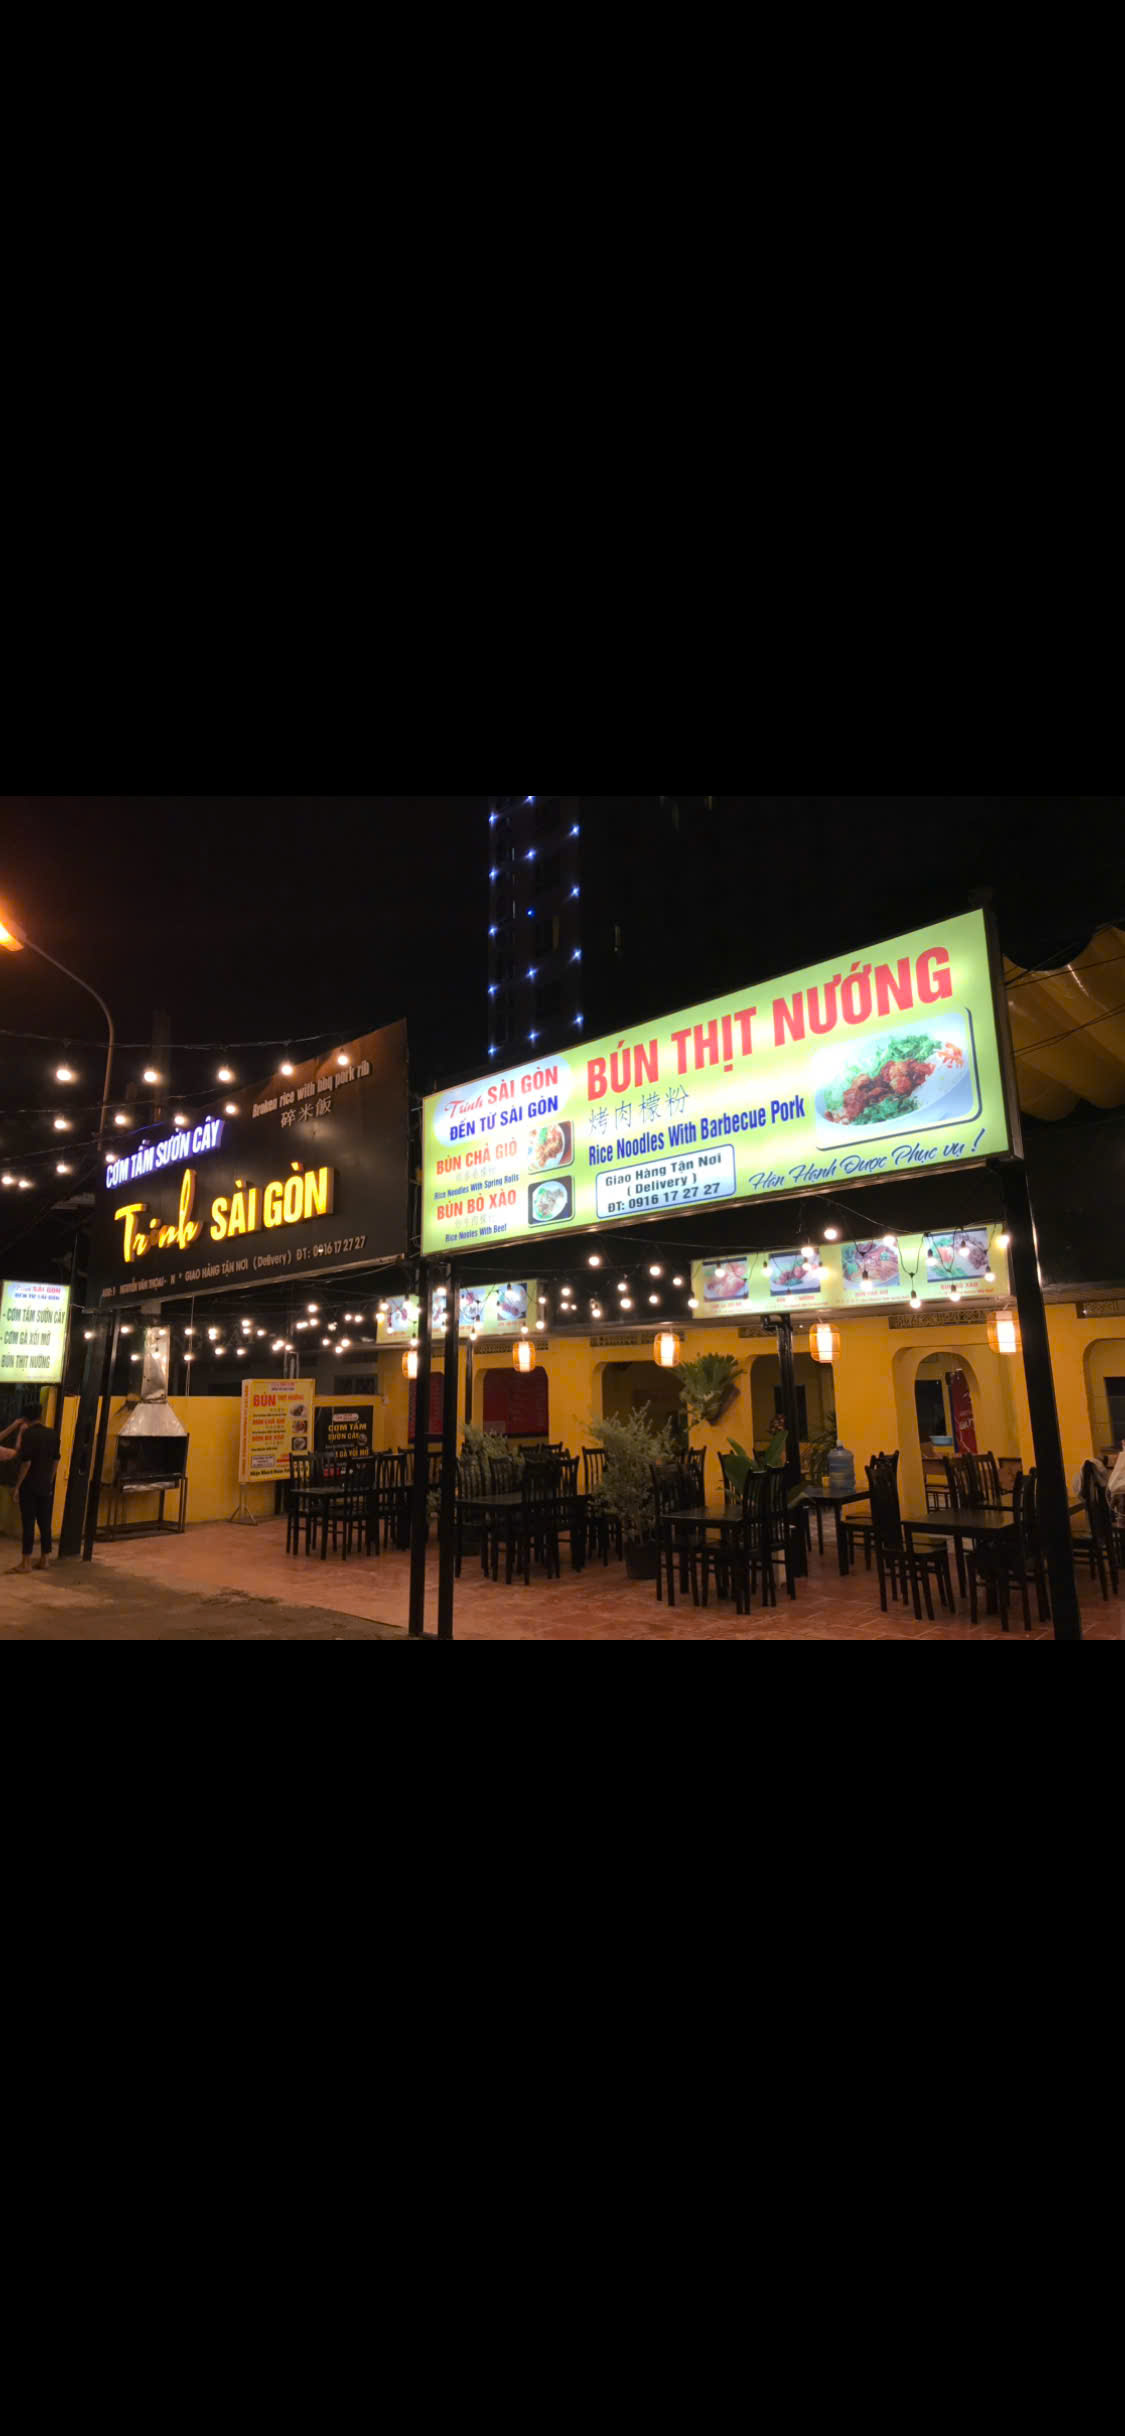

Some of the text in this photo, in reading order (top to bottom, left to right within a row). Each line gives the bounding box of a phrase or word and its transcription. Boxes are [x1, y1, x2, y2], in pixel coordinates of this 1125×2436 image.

[587, 946, 952, 1101] BÚN THỊT NƯỚNG
[279, 1091, 295, 1108] rice
[297, 1081, 315, 1101] with
[335, 1066, 355, 1088] pork
[357, 1060, 370, 1078] rib
[488, 1079, 515, 1104] SÀI
[521, 1066, 558, 1094] GÒN
[192, 1115, 221, 1153] CÂY
[450, 1095, 558, 1141] ĐẾN TỪ SÀI GÒN
[589, 1095, 805, 1166] Rice Noodles With Barbecue Pork
[436, 1155, 461, 1175] BÚN
[465, 1143, 491, 1167] CHẢ
[605, 1153, 721, 1187] Giao Hàng Tận Nơi
[748, 1170, 784, 1190] Hân
[788, 1158, 837, 1184] Hạnh
[891, 1142, 938, 1165] Phục
[943, 1142, 965, 1157] vụ
[437, 1200, 463, 1220] BÚN
[467, 1193, 485, 1214] BÒ
[489, 1188, 517, 1209] XÀO
[471, 1182, 482, 1191] With
[608, 1182, 720, 1213] ĐT: 0916 17 27 27
[635, 1176, 687, 1195] Delivery
[114, 1161, 330, 1263] Trinh SÀI GÒN
[480, 1226, 492, 1236] With
[185, 1269, 200, 1282] GIAO
[334, 1240, 342, 1253] 17
[343, 1238, 353, 1252] 27
[355, 1235, 366, 1249] 27
